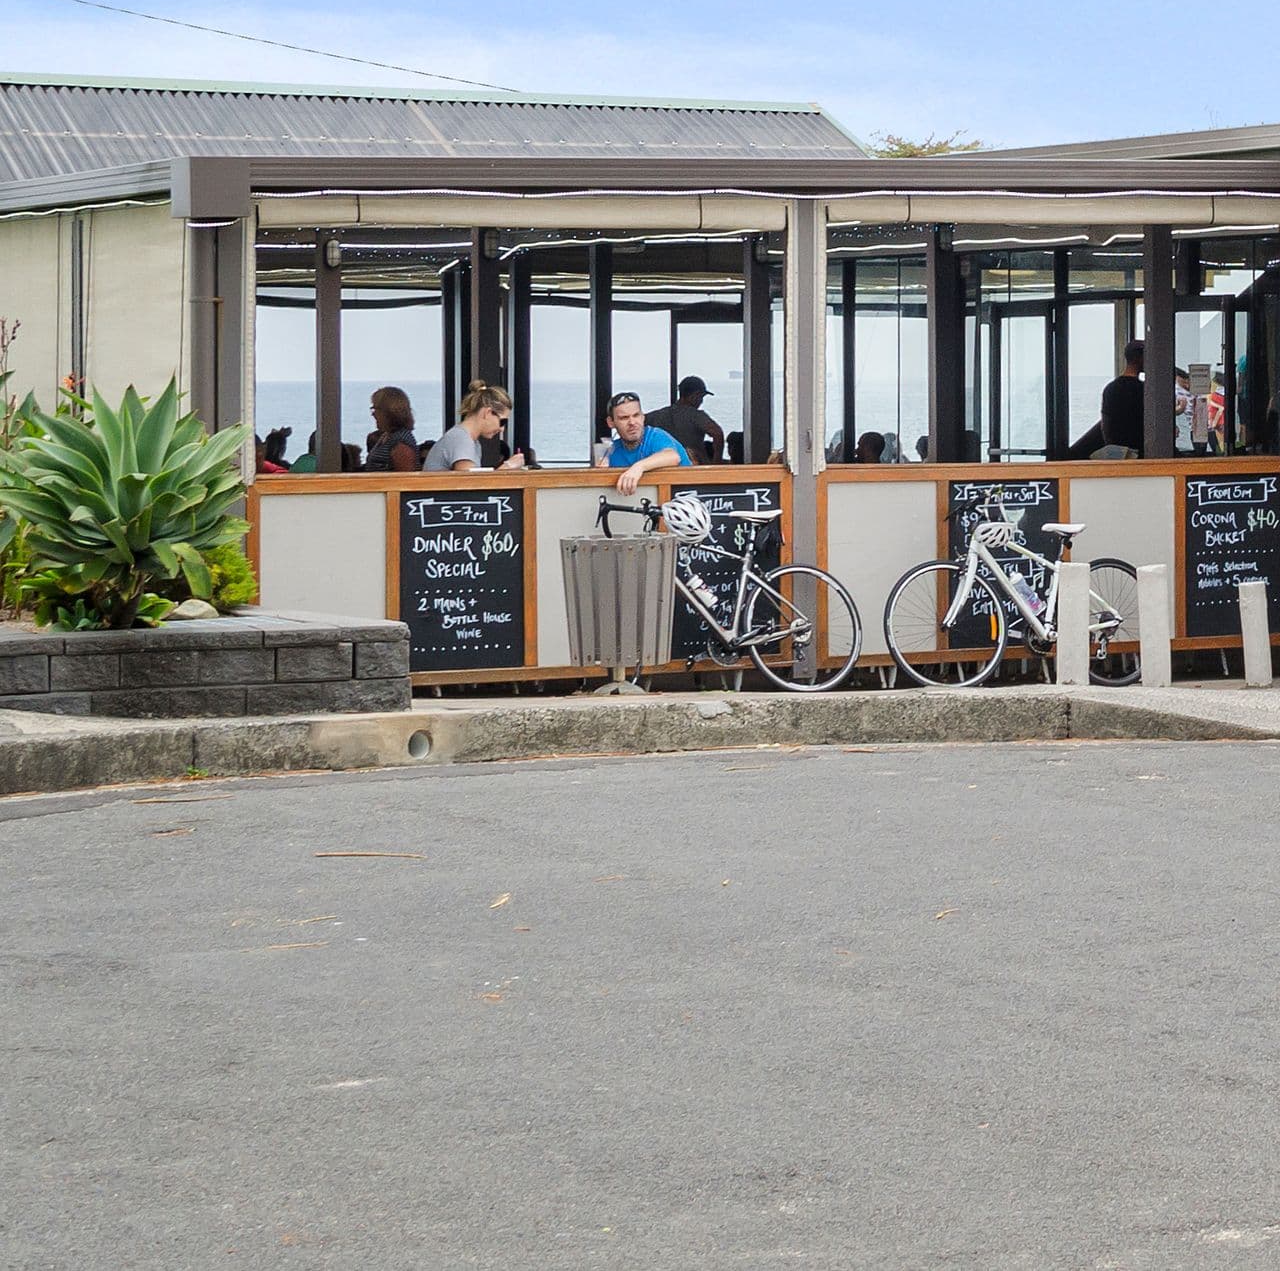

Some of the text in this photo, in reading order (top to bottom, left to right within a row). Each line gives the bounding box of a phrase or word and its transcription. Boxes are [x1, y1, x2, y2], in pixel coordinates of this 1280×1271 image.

[1208, 486, 1231, 500] FROM
[1191, 510, 1238, 529] CORONA
[412, 532, 477, 560] DINNER
[1205, 528, 1247, 547] BUCKET
[425, 559, 486, 579] SPECIAL
[1232, 574, 1240, 587] 5
[417, 597, 478, 613] 2 MAINS +
[441, 611, 512, 629] BOTTLE HOUSE
[456, 628, 483, 640] WINE
